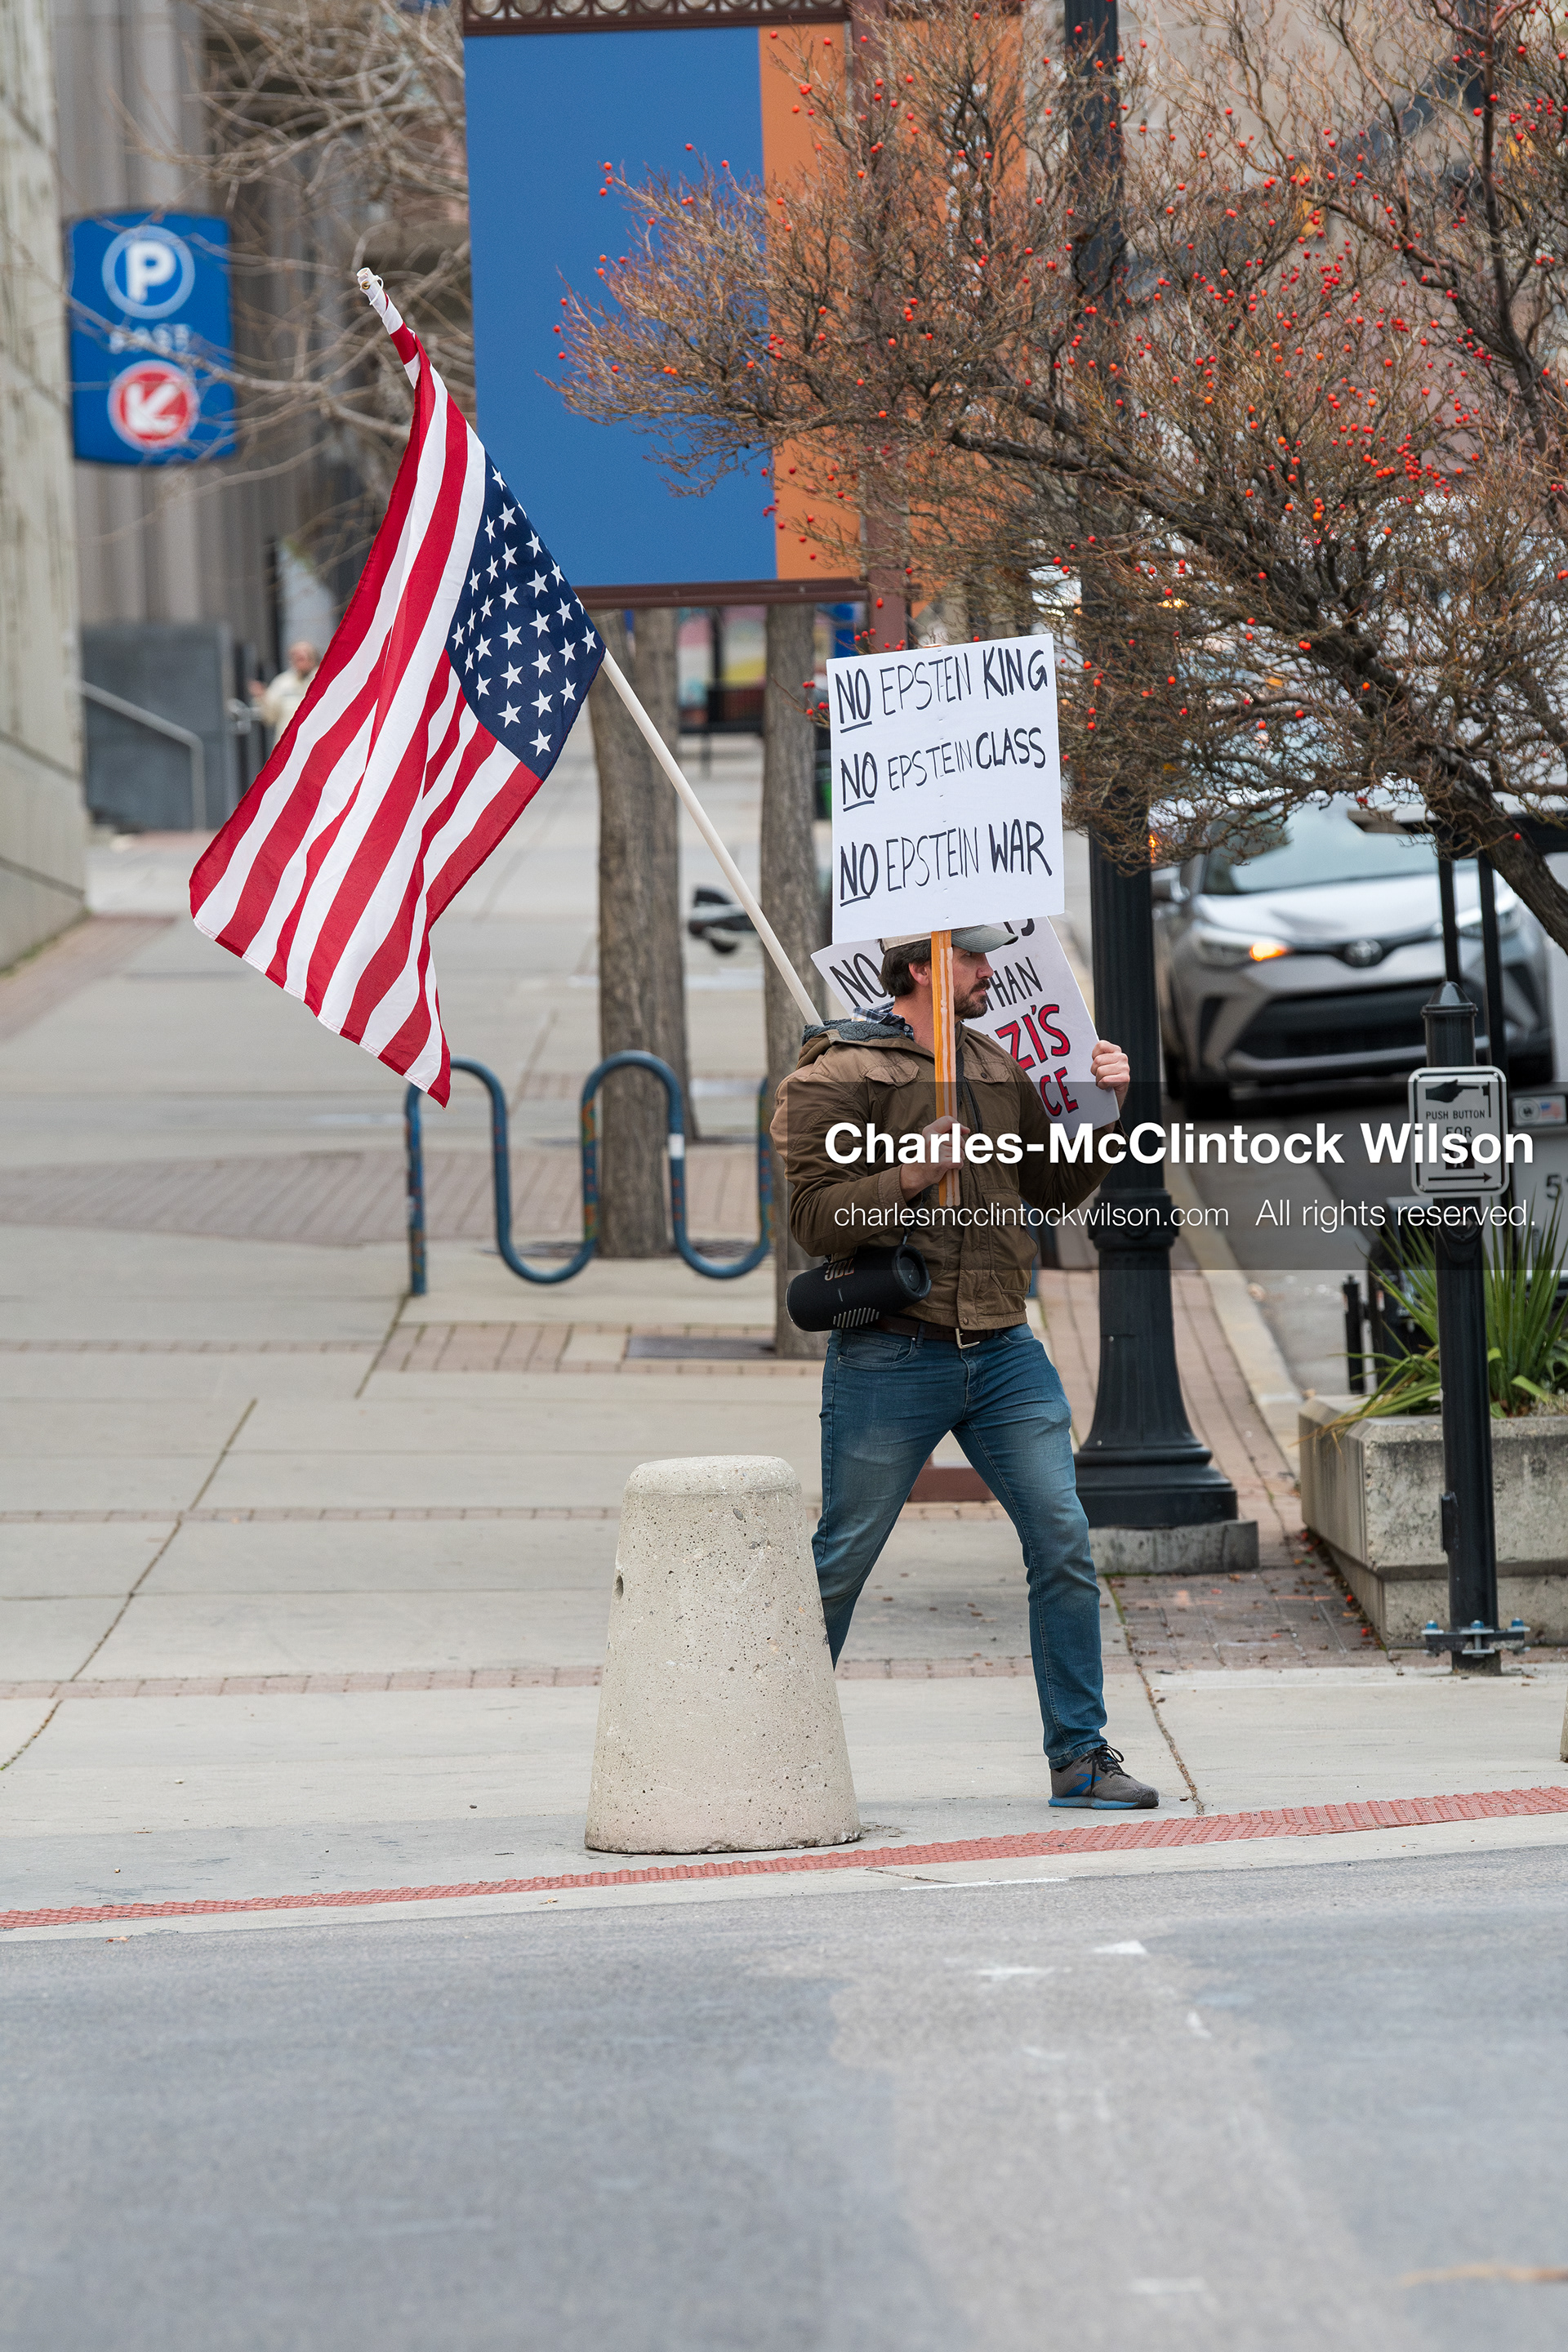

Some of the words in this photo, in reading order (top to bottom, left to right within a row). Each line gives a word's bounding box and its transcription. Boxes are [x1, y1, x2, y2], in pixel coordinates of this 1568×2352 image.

[835, 668, 871, 724] NO
[880, 652, 972, 716] EPSTEN
[983, 646, 1049, 700] KING
[840, 751, 877, 805] NO
[888, 739, 973, 791] EPSTEIN
[975, 726, 1046, 769] CLASS
[840, 841, 879, 901] NO
[886, 826, 980, 893] EPSTEIN
[988, 818, 1053, 876] WAR
[994, 1003, 1071, 1071] ZI'S
[1039, 1066, 1080, 1117] CE
[1426, 1111, 1449, 1120] PUSH
[1453, 1110, 1486, 1119] BUTTON
[824, 1258, 854, 1281] JBL
